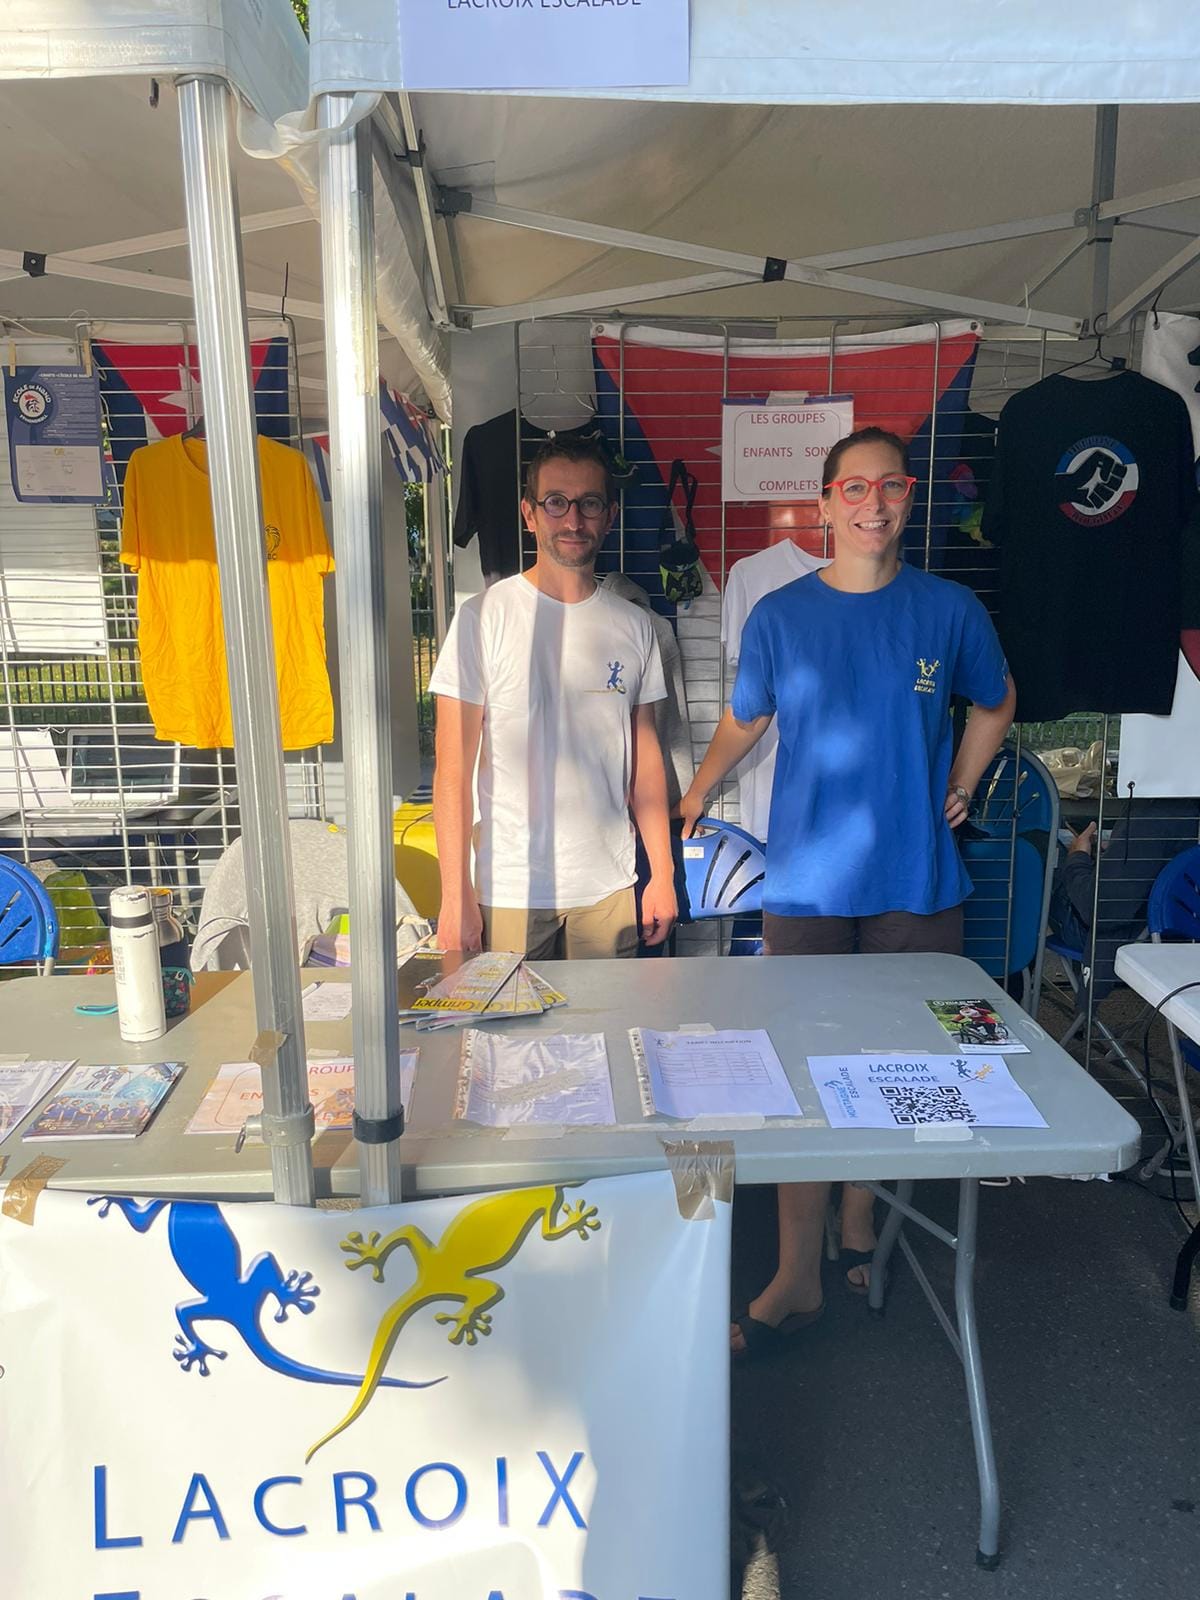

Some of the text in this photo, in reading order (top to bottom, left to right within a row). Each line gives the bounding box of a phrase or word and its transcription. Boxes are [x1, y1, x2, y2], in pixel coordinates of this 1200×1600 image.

[750, 412, 826, 424] LES GROUPES
[743, 447, 793, 458] ENFANTS
[759, 480, 819, 491] COMPLETS
[869, 1063, 930, 1073] LACROIX
[868, 1075, 941, 1083] ESCALADE
[94, 1450, 589, 1551] LACROIX
